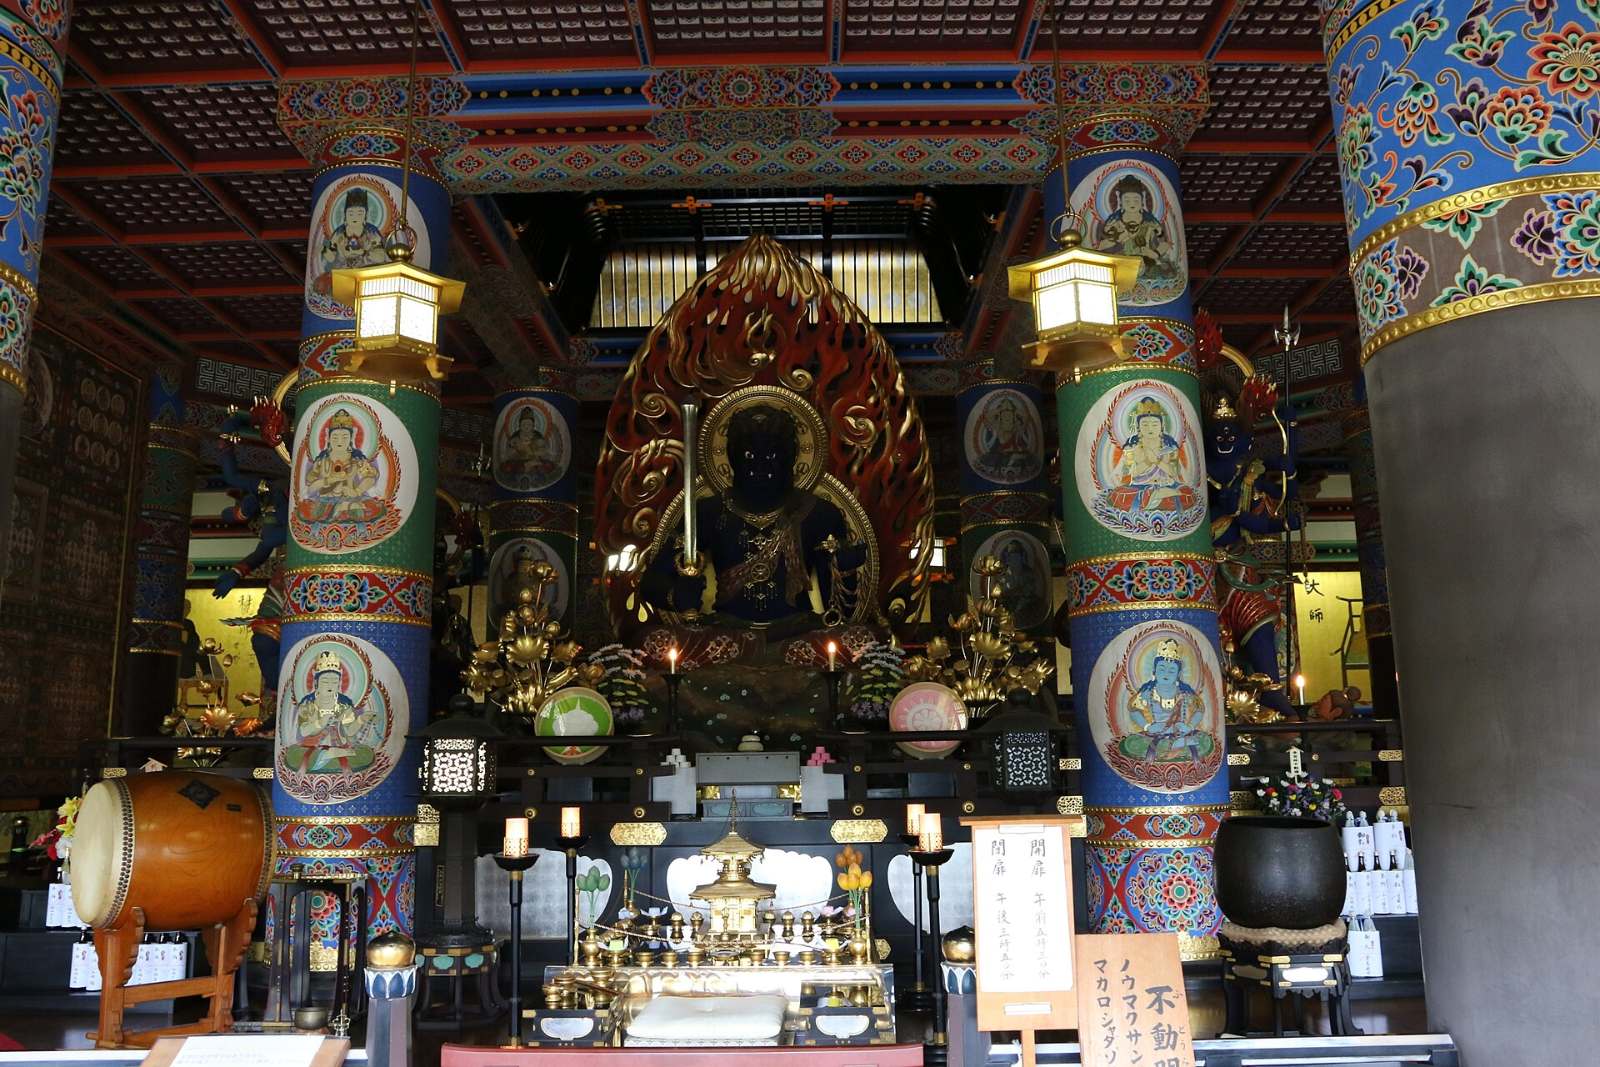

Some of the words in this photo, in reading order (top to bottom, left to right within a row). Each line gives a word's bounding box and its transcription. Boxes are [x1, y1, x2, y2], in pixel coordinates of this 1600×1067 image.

[1030, 838, 1047, 877] 開扉
[1120, 958, 1143, 1065] ノウマクサン
